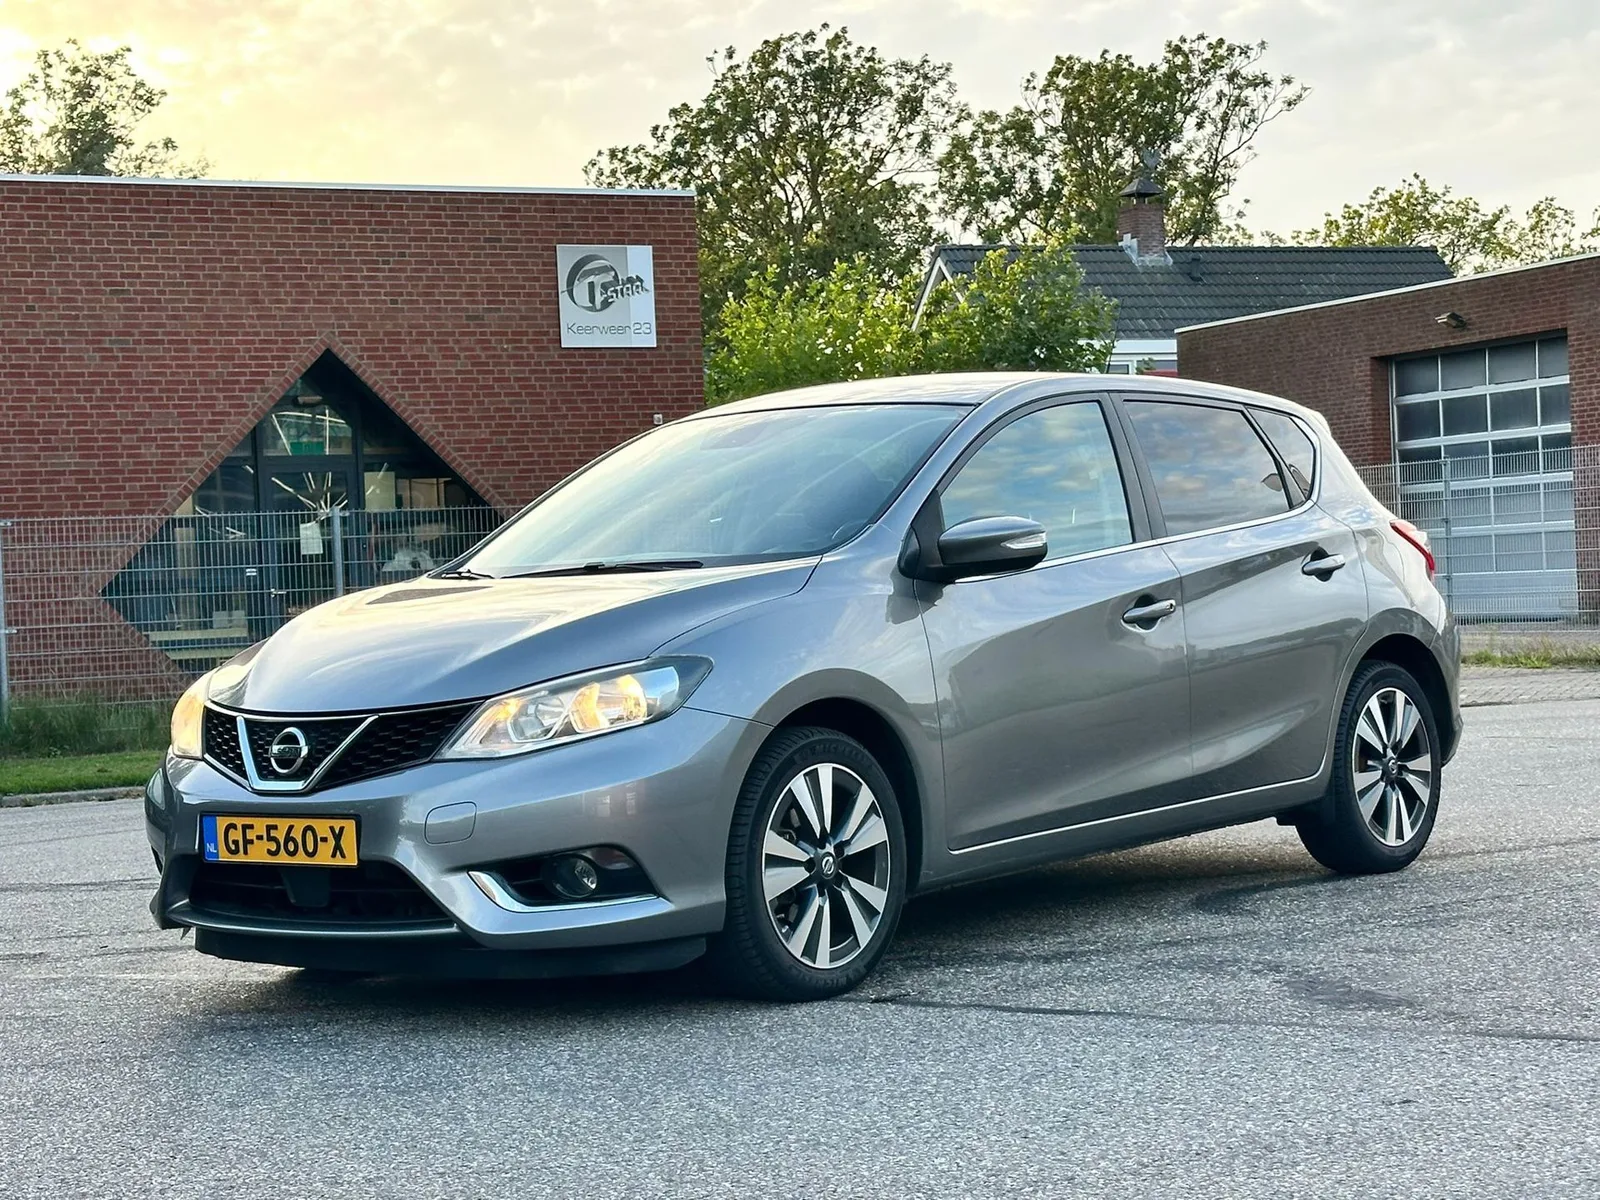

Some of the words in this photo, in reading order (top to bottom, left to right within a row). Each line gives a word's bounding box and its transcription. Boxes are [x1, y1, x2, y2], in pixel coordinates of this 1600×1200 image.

[566, 322, 631, 335] Keerweer
[632, 322, 652, 335] 23
[206, 843, 217, 853] NL
[223, 822, 346, 859] GF-560-X
